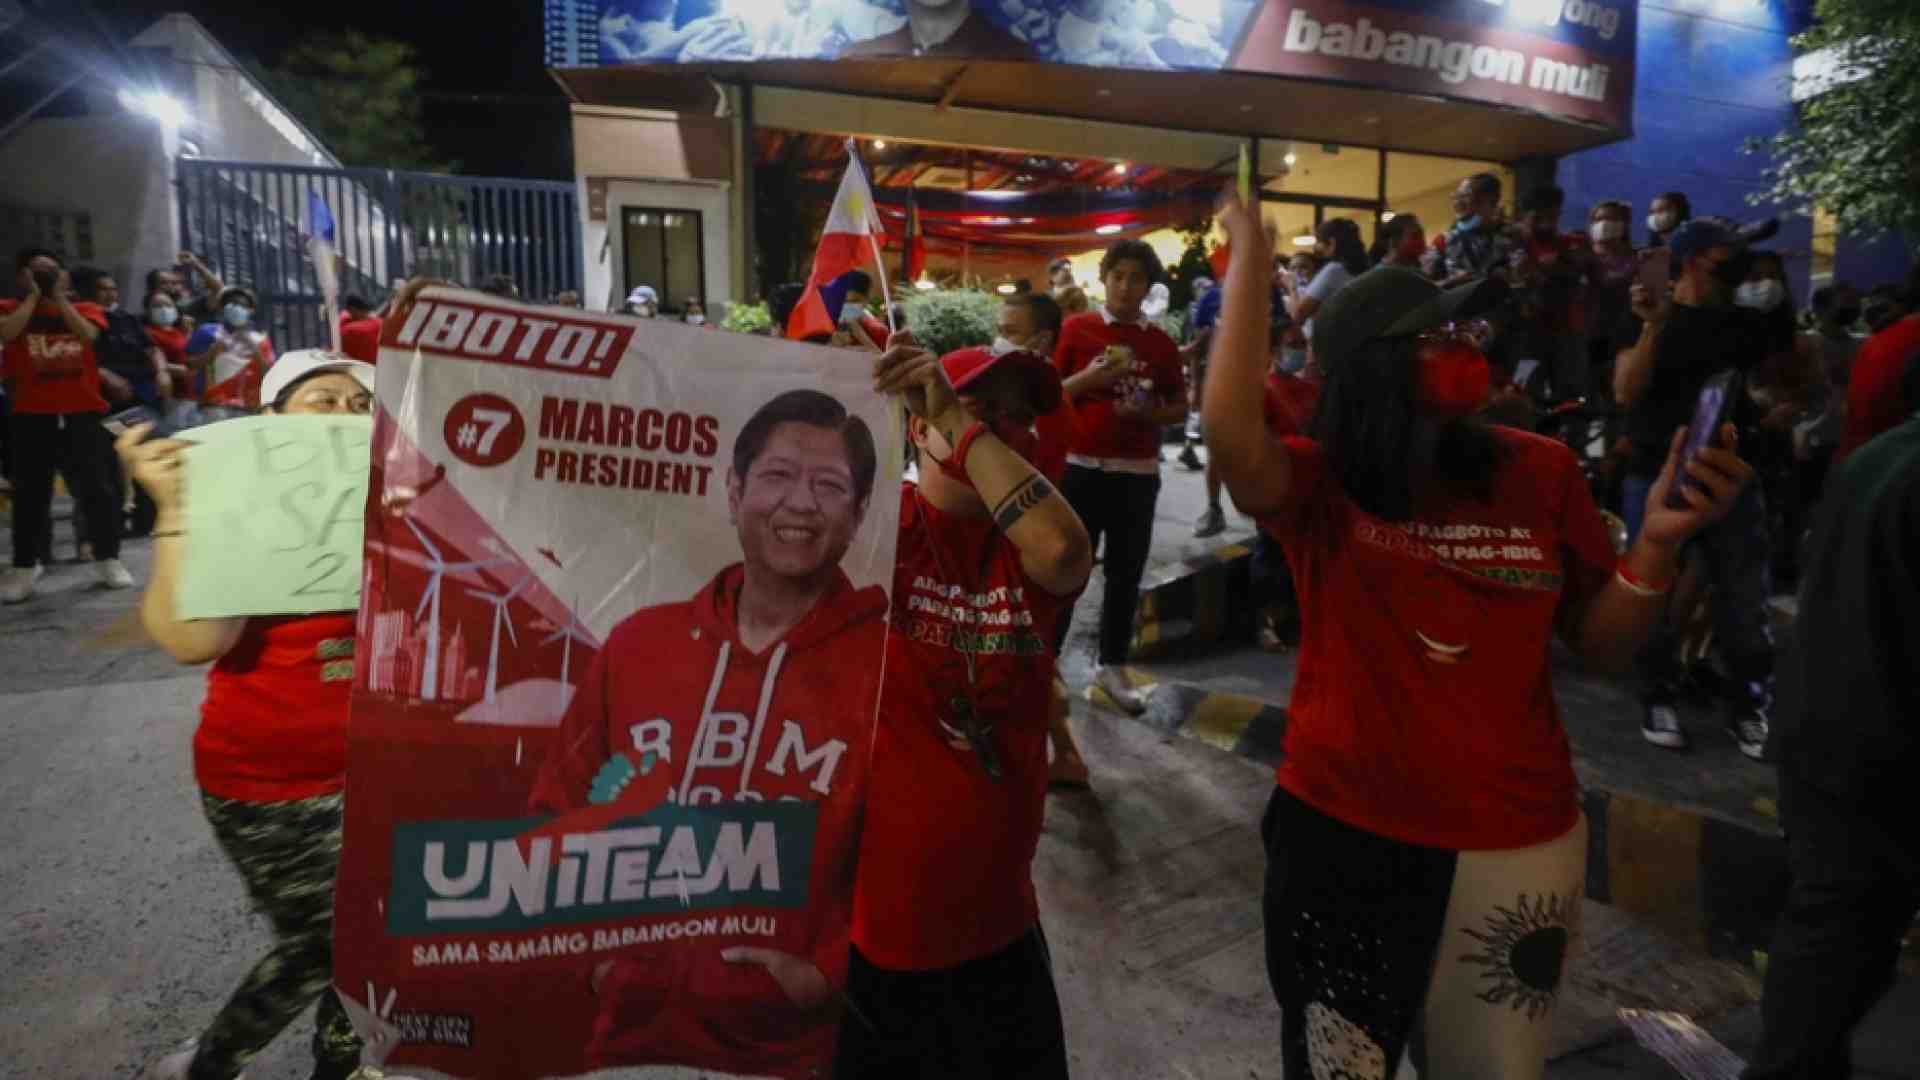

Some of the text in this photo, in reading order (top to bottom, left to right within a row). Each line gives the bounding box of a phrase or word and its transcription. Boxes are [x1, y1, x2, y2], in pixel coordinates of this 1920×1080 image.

[1282, 9, 1610, 101] babangon muli
[396, 301, 618, 370] IBOTO!
[456, 407, 512, 456] #7
[538, 396, 719, 458] MARCOS
[534, 448, 714, 497] PRESIDENT
[1453, 545, 1545, 562] PAG-IBIG
[592, 919, 719, 951] BABANGON
[721, 916, 777, 937] MULI
